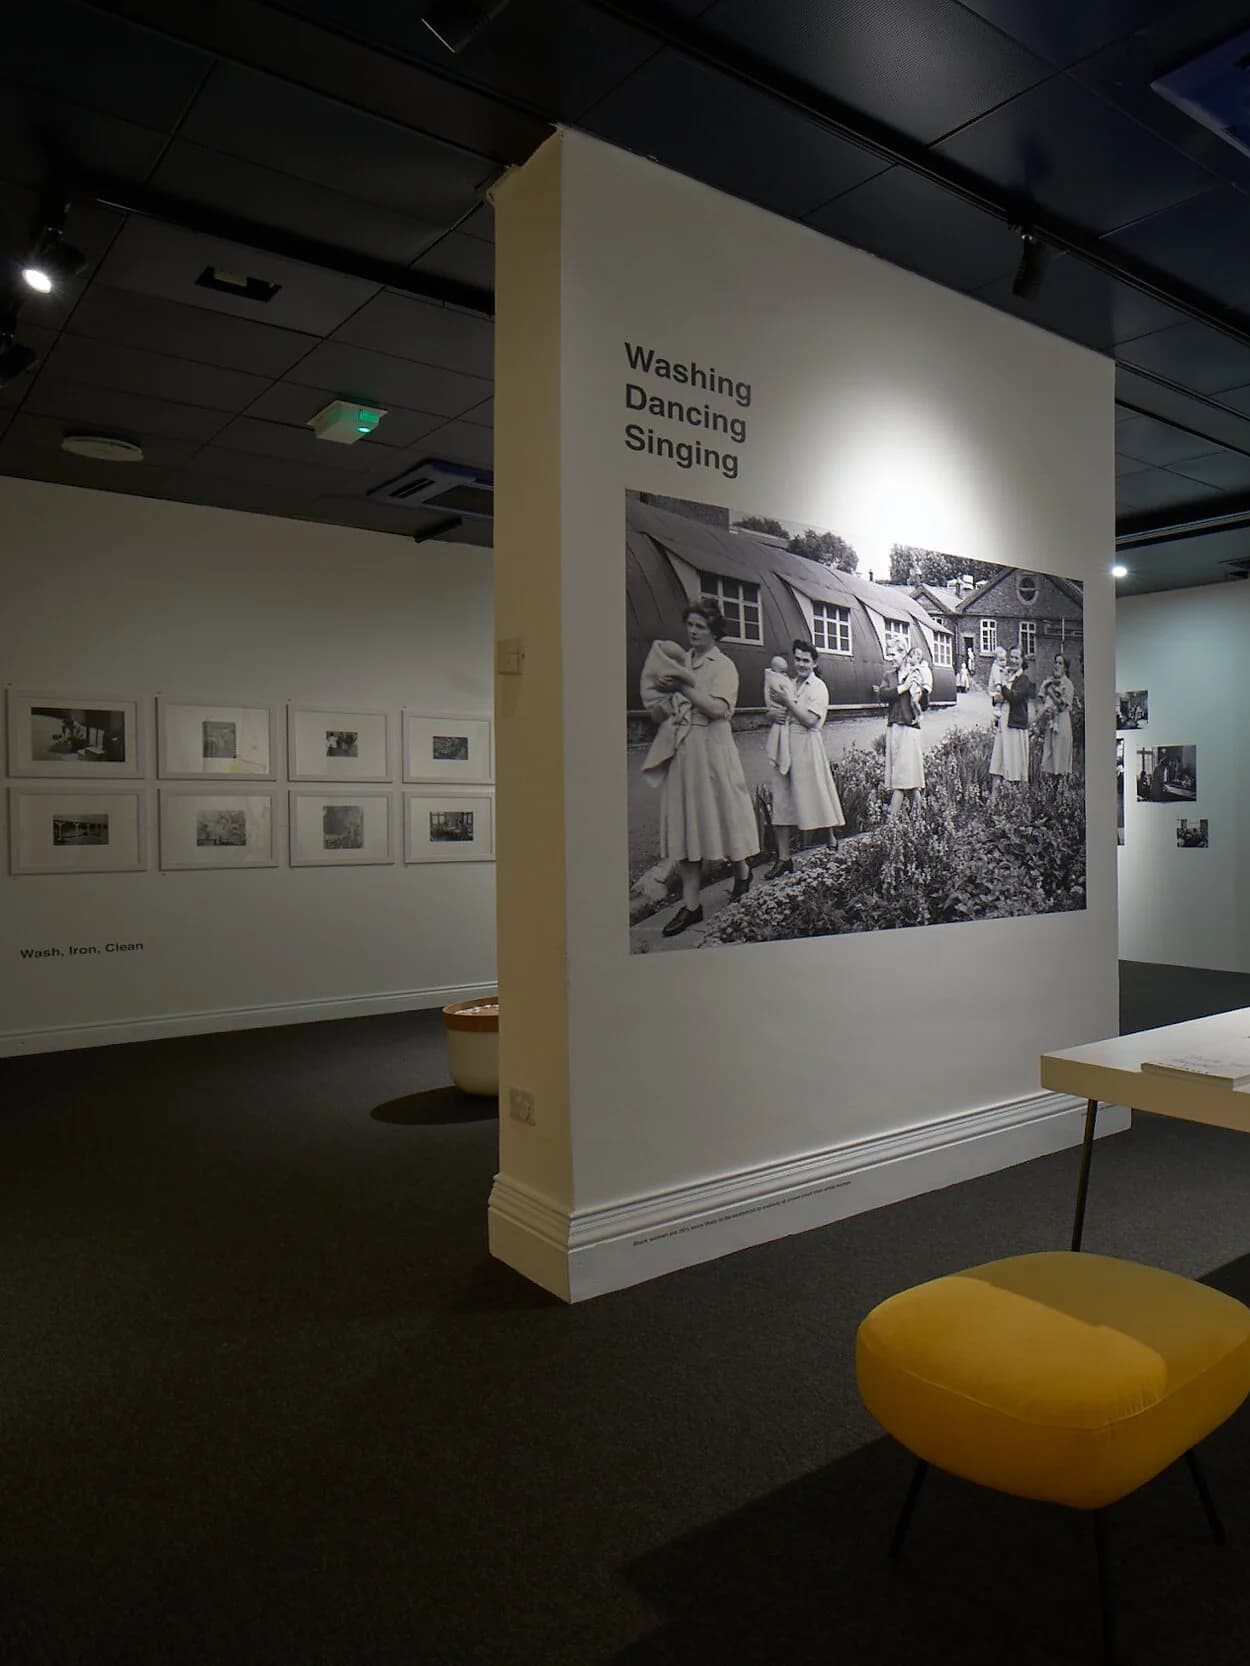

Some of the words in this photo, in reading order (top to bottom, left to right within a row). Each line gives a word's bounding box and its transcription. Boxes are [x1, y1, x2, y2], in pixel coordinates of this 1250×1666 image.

[624, 342, 752, 408] Washing
[625, 383, 747, 444] Dancing
[625, 423, 739, 480] Singing
[19, 947, 65, 960] Wash,
[68, 945, 101, 956] Iron,
[104, 942, 144, 953] Clean
